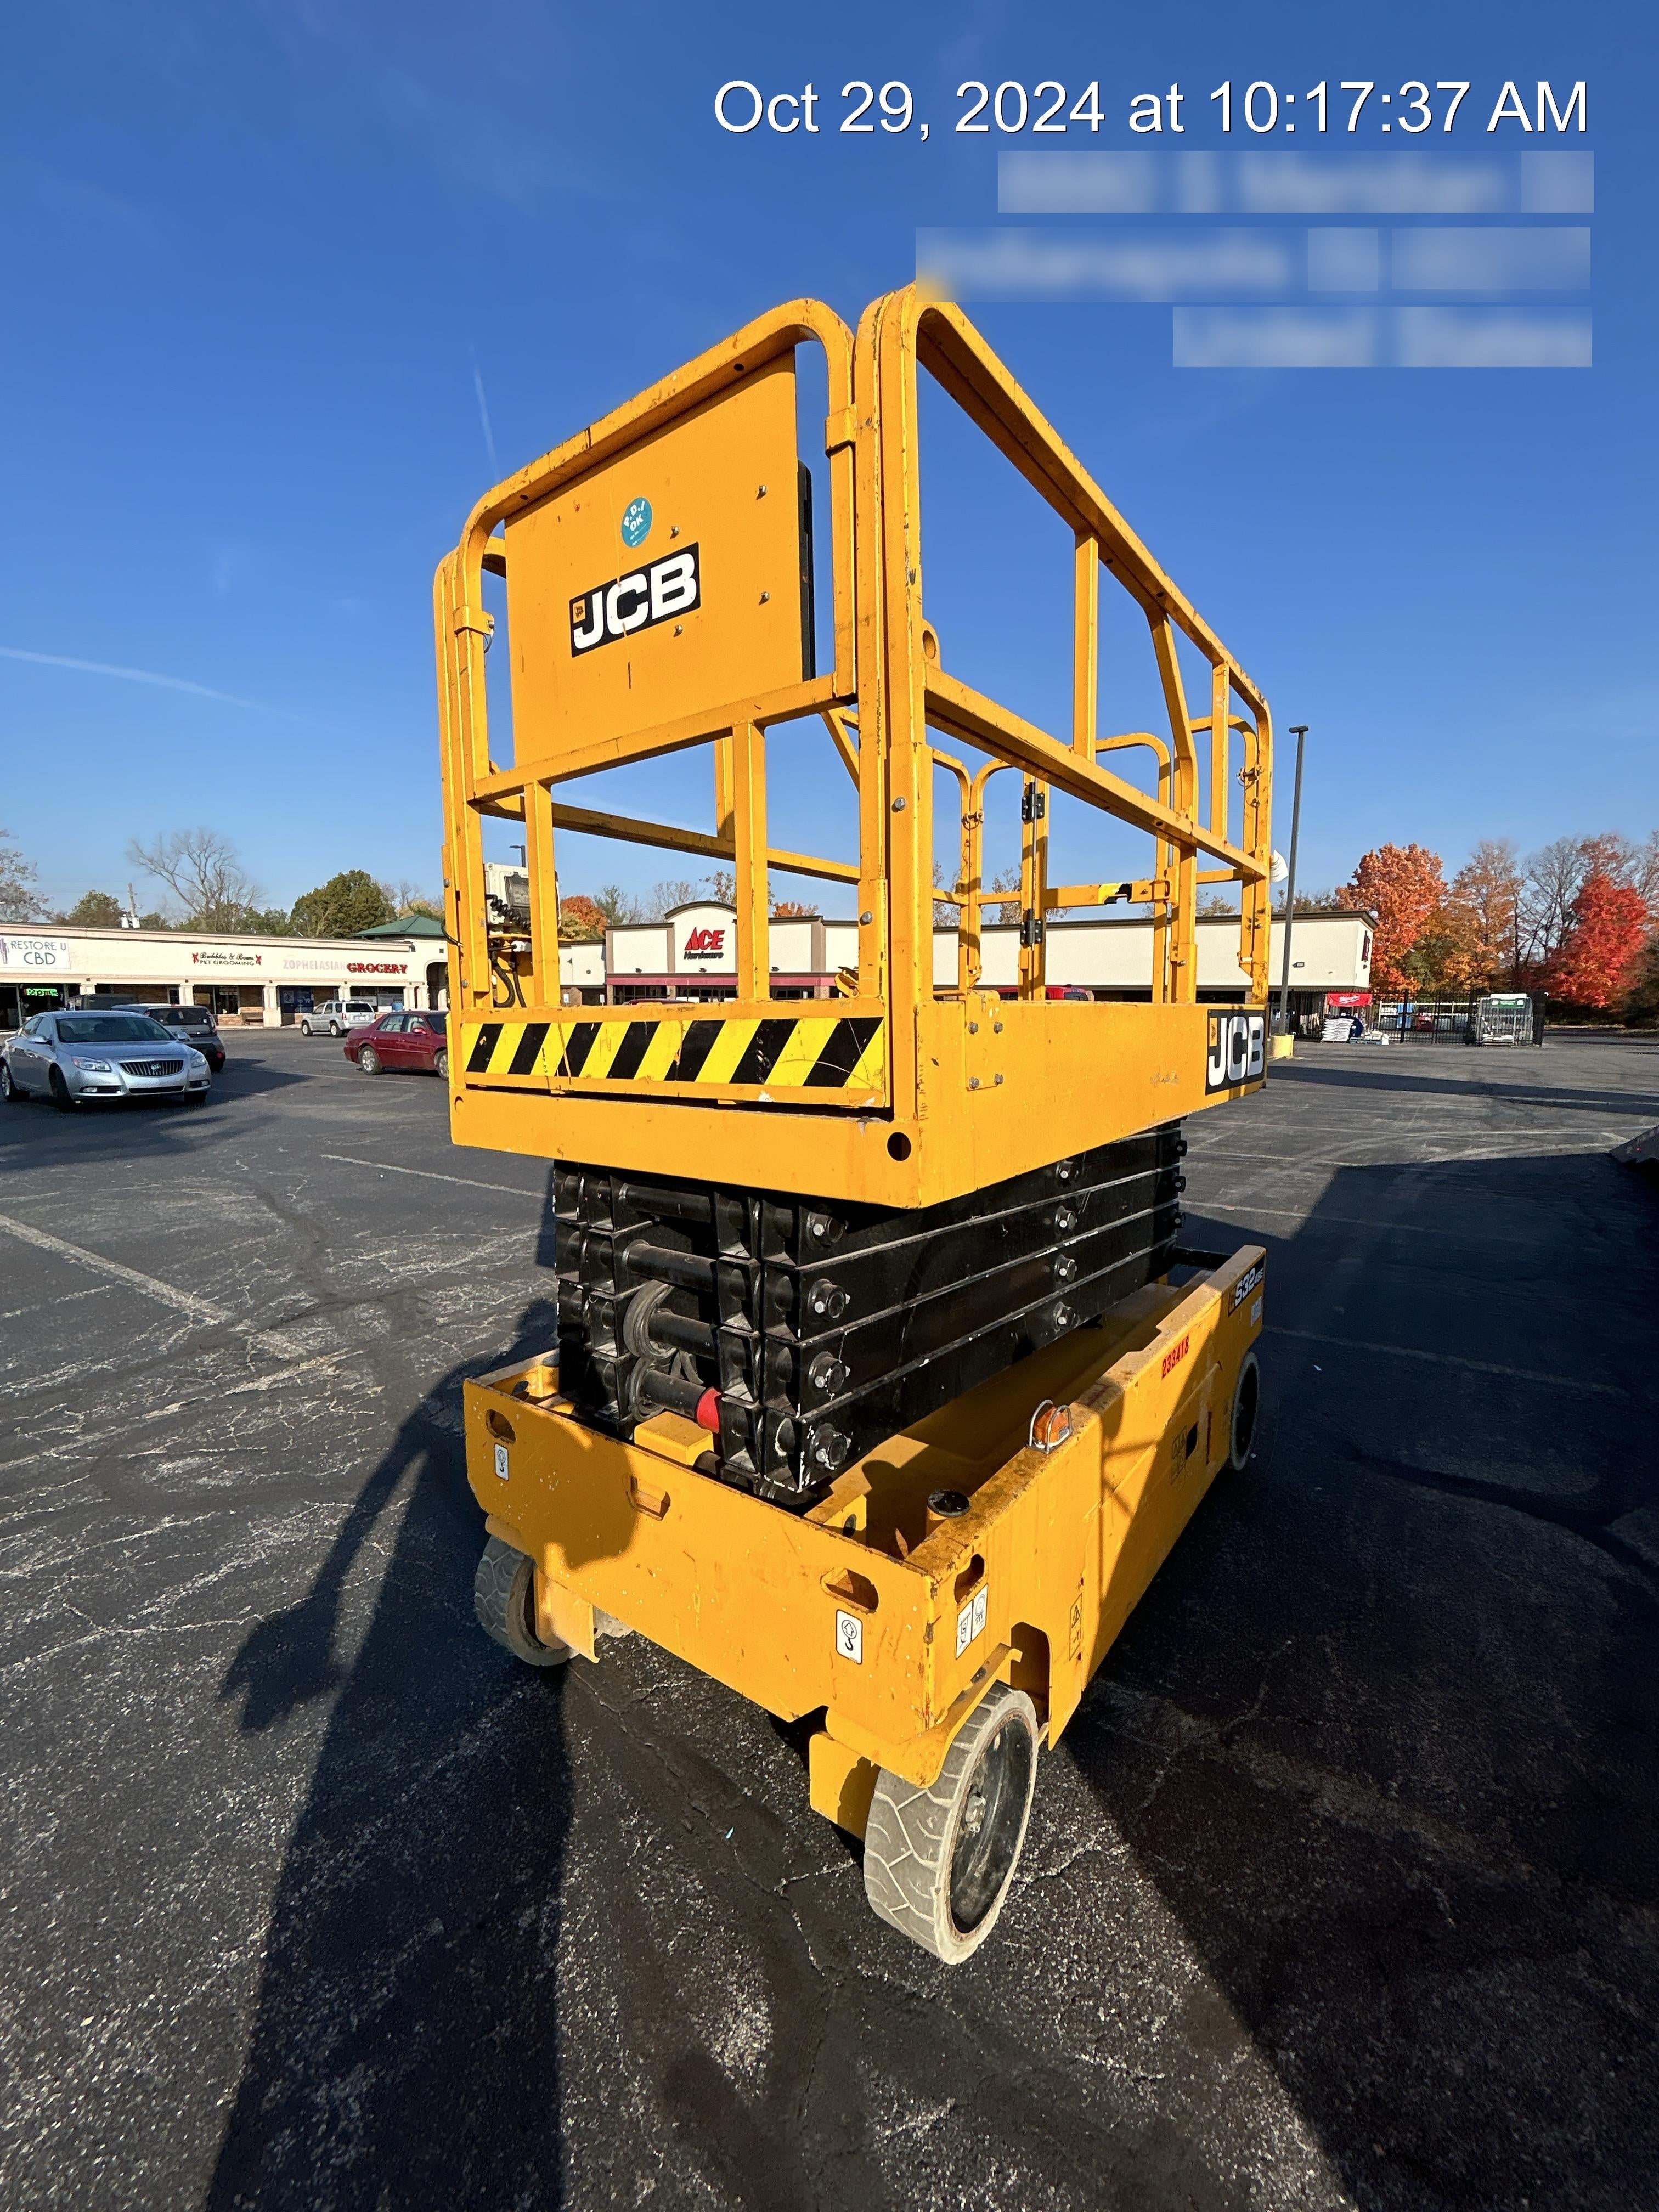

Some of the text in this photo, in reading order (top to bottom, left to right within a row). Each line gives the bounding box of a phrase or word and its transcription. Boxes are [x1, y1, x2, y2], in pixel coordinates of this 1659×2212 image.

[630, 514, 644, 531] OK
[573, 553, 697, 649] JCB
[10, 940, 66, 951] RESTORE U
[684, 927, 725, 951] ACE
[24, 952, 56, 965] CBD
[684, 951, 724, 960] Hardware
[347, 963, 408, 974] GROCERY
[1208, 1017, 1265, 1086] JCB
[1161, 1335, 1189, 1380] 233418
